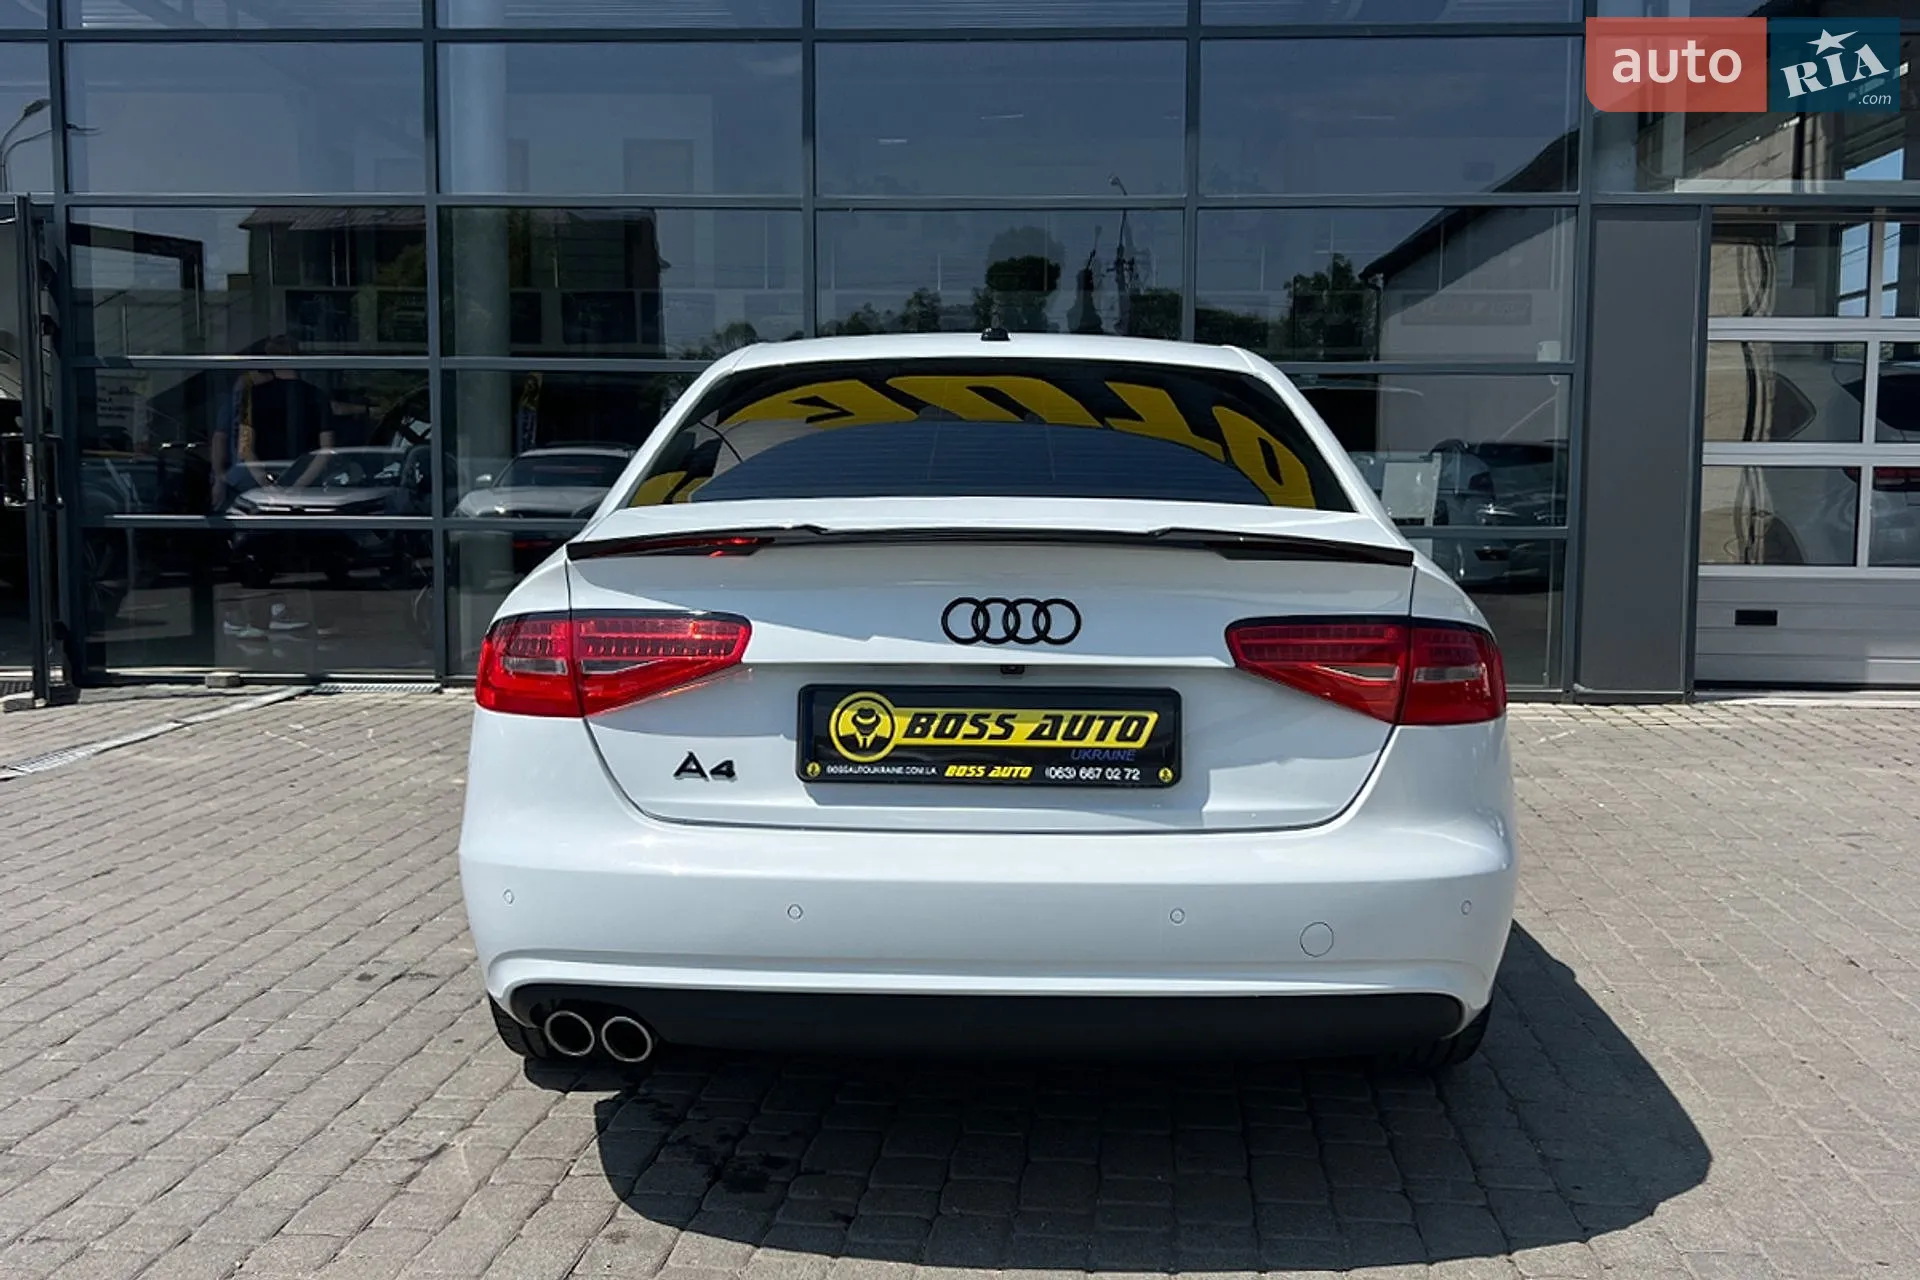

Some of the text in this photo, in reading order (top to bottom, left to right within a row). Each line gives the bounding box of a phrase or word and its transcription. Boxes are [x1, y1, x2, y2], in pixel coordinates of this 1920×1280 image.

[903, 712, 1151, 742] BOSS AUTO
[1070, 748, 1137, 762] UKRAINE
[673, 751, 737, 781] A4
[944, 765, 1033, 778] BOSS AUTO
[1105, 767, 1121, 780] 02
[1124, 767, 1140, 780] 72
